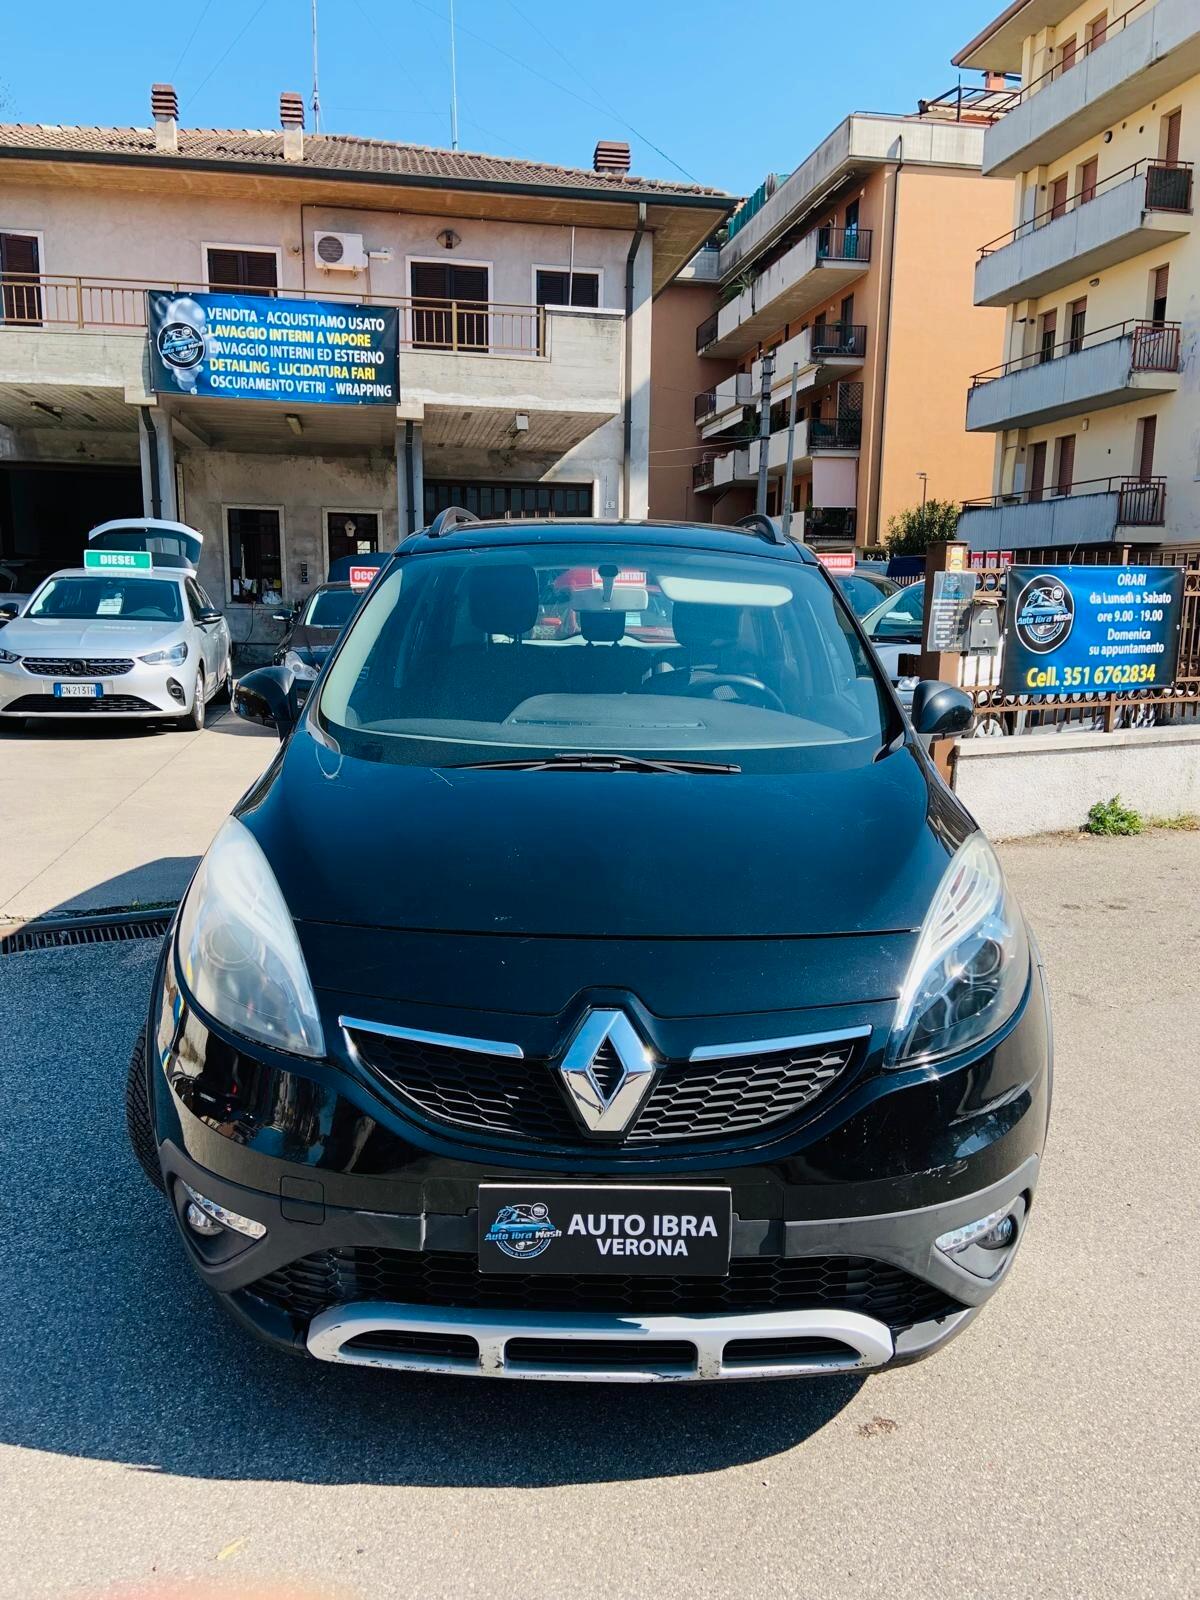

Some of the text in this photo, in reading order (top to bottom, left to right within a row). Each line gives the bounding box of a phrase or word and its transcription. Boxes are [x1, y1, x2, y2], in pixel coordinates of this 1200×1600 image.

[207, 307, 258, 323] VENDITA
[266, 311, 346, 329] ACQUISTIAMO
[348, 316, 385, 331] USATO
[207, 324, 371, 347] LAVAGGIO INTERNI A VAPORE
[209, 341, 268, 357] LAVAGGIO
[270, 345, 314, 360] INTERNI
[317, 348, 332, 361] ED
[334, 349, 385, 365] ESTERNO
[210, 358, 270, 374] DETAILING
[278, 362, 350, 379] LUCIDATURA
[351, 367, 376, 380] FARI
[210, 374, 294, 392] OSCURAMENTO
[295, 380, 326, 394] VETRI
[335, 382, 392, 397] WRAPPING
[100, 554, 136, 566] DIESEL
[354, 570, 377, 581] OCC
[1117, 573, 1147, 586] ORARI
[1089, 591, 1171, 605] da Lunedì a Sabato
[1097, 612, 1112, 622] ore
[1114, 610, 1133, 622] 9.00
[1140, 609, 1163, 621] 19.00
[1107, 627, 1151, 640] Domenica
[1089, 642, 1164, 658] su appuntamento
[1026, 663, 1156, 687] Cell. 351 6762834
[567, 1213, 718, 1237] AUTO IBRA
[484, 1229, 562, 1241] Auto Ibra Wash
[596, 1238, 688, 1256] VERONA
